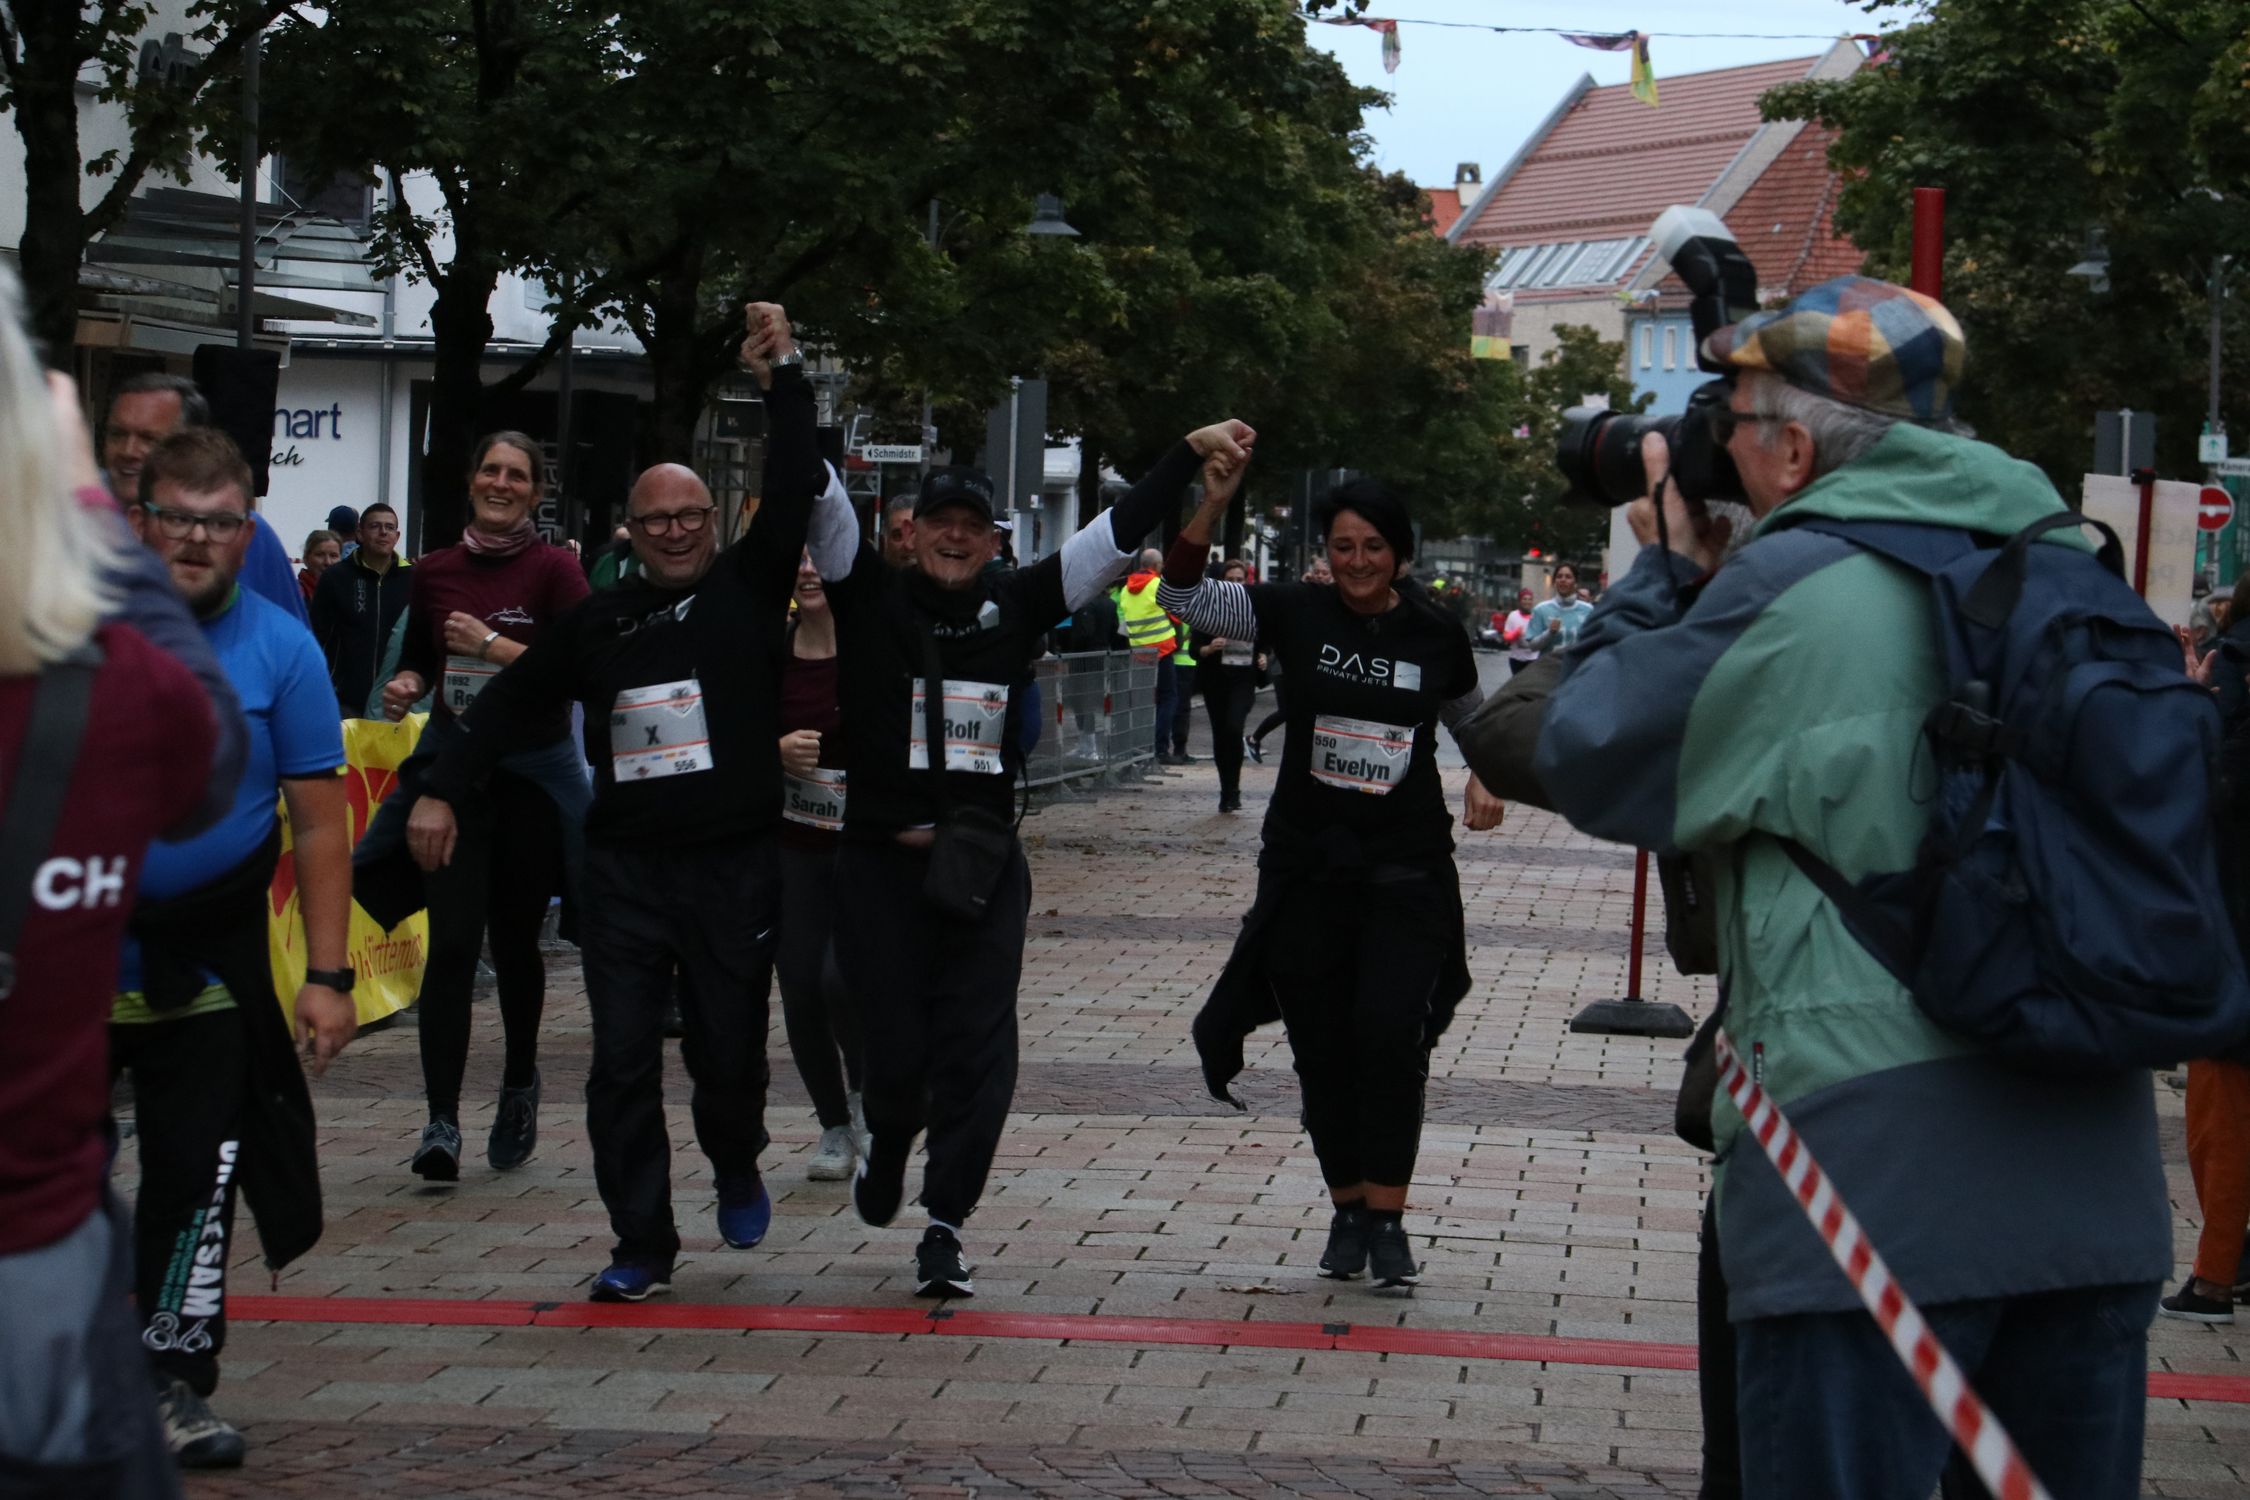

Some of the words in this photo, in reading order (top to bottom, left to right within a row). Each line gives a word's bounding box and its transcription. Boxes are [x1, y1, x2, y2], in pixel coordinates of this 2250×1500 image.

[1319, 643, 1390, 678] DAS
[1316, 664, 1359, 682] PRIVATE
[1361, 677, 1388, 687] JETS
[644, 724, 662, 746] X
[943, 719, 981, 740] Rolf
[1314, 735, 1337, 748] 550
[1323, 751, 1391, 782] Evelyn
[791, 793, 838, 818] Sarah
